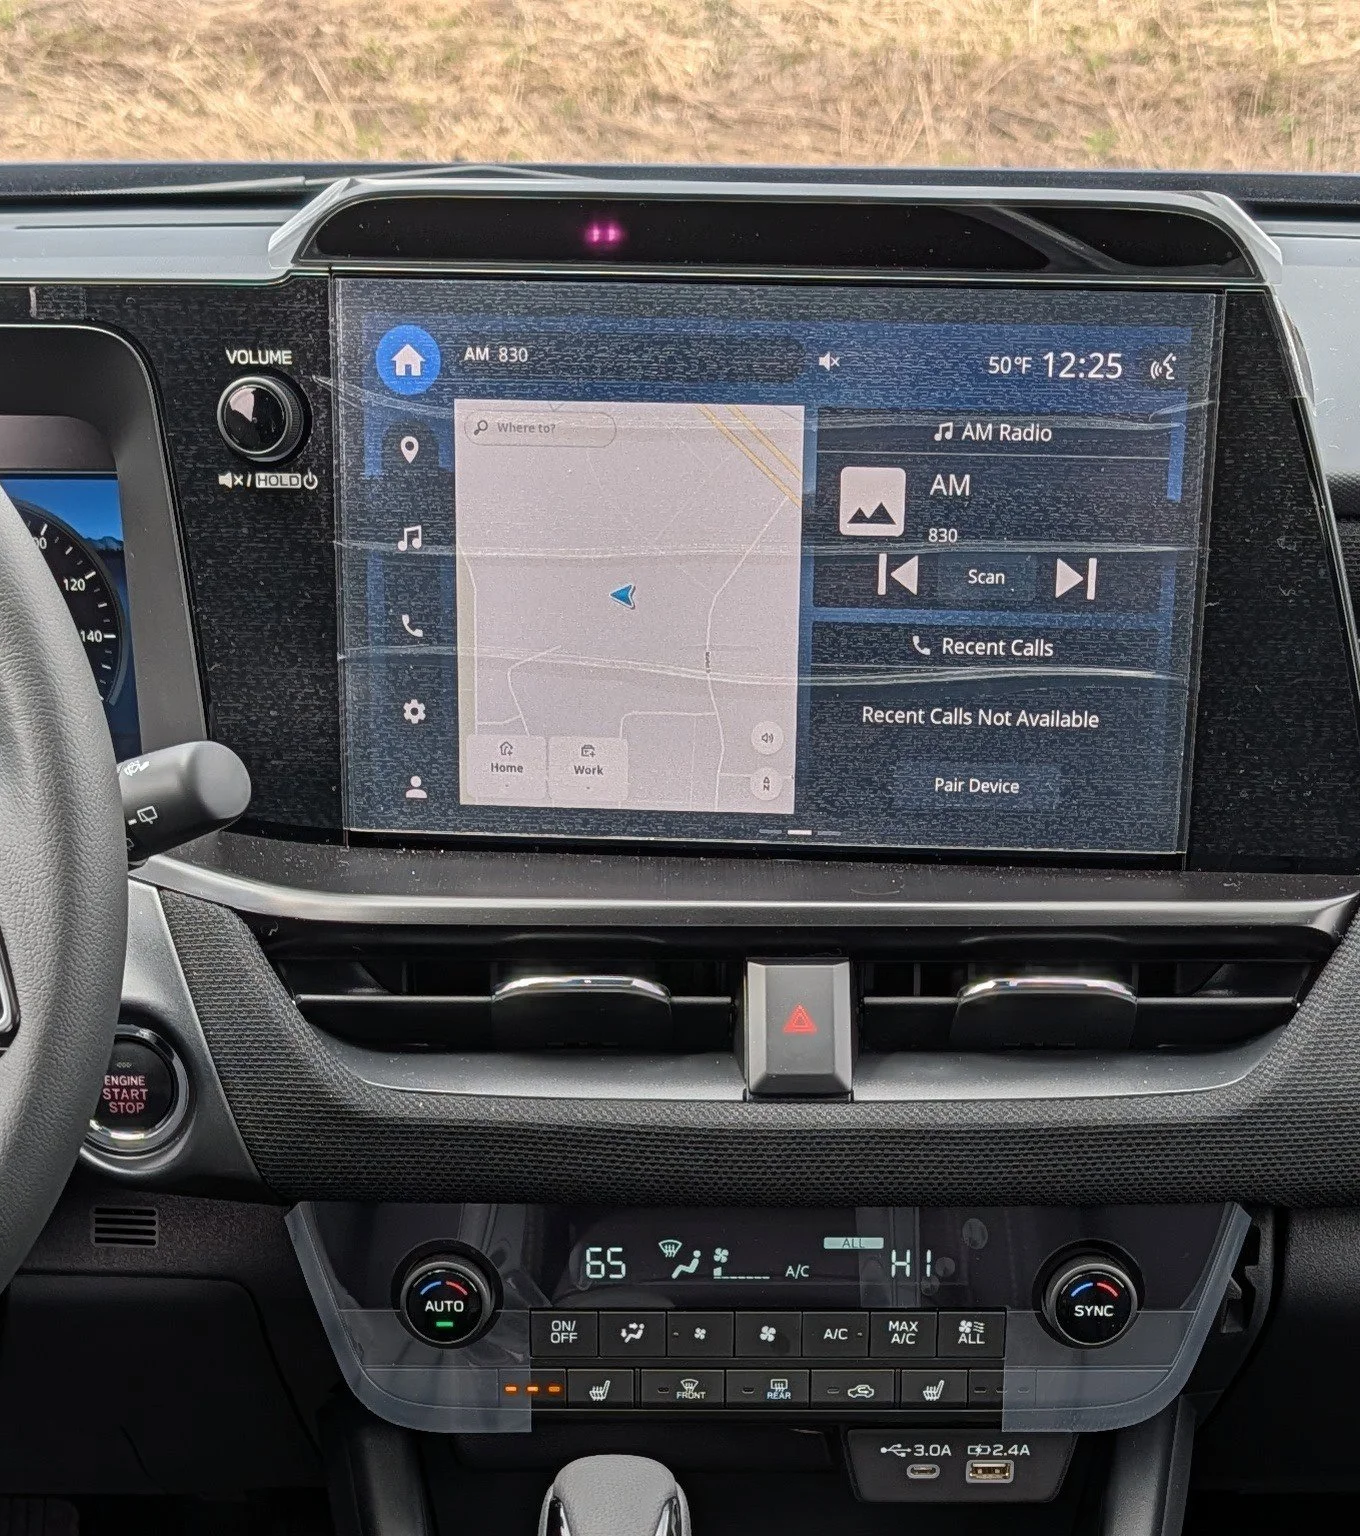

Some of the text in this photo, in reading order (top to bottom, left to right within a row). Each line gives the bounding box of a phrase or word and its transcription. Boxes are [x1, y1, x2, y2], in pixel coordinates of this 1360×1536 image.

[226, 350, 292, 366] VOLUME
[464, 347, 528, 363] AM 830
[1043, 352, 1123, 380] 12:25
[498, 422, 556, 435] Where to?
[961, 423, 1052, 442] AM Radio
[258, 474, 300, 488] HOLD
[930, 474, 971, 497] AM
[928, 528, 958, 544] 830
[968, 569, 1006, 586] Scan
[64, 578, 86, 592] 120
[81, 630, 102, 644] 140
[942, 638, 1054, 658] Recent Calls
[862, 706, 1099, 729] Recent Calls Not Available
[490, 762, 524, 773] Home
[574, 764, 603, 775] Work
[935, 778, 1020, 794] Pair Device
[104, 1075, 145, 1086] ENGINE
[102, 1089, 148, 1100] START
[109, 1102, 145, 1113] STOP
[585, 1247, 626, 1279] 65
[785, 1265, 810, 1278] A/C
[425, 1300, 464, 1313] AUTO
[1074, 1304, 1114, 1318] SYNC
[551, 1320, 576, 1333] ON/
[888, 1320, 919, 1333] MAX
[550, 1330, 578, 1344] OFF
[824, 1328, 848, 1341] A/C
[891, 1332, 915, 1345] A/C
[958, 1332, 985, 1345] ALL
[676, 1391, 706, 1400] FRONT
[766, 1390, 792, 1400] REAR
[913, 1444, 1031, 1457] 3.0A 2.4A
